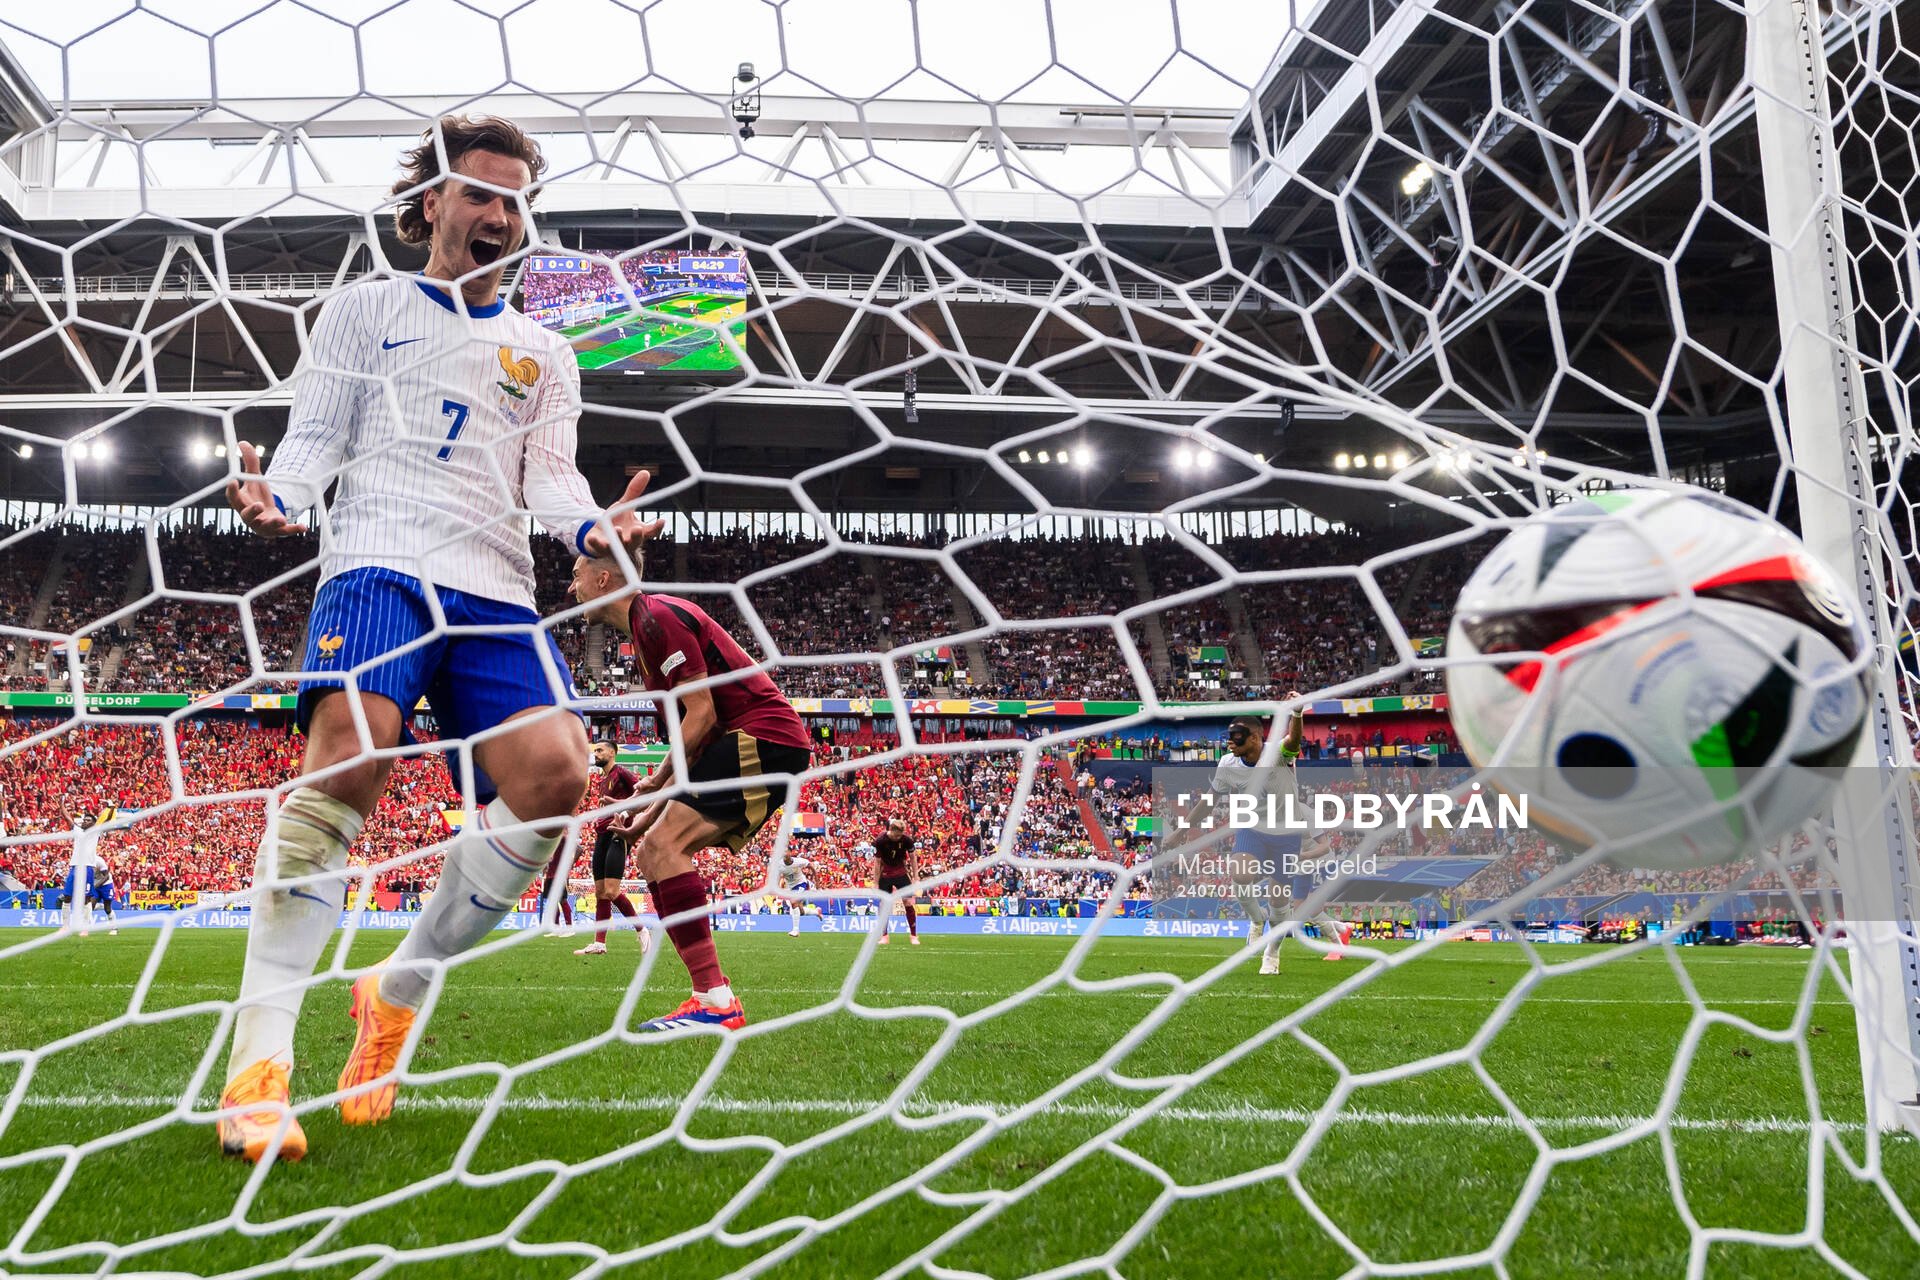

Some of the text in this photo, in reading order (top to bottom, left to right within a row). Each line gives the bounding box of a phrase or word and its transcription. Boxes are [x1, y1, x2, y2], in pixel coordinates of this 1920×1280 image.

[692, 261, 725, 270] 84:29
[437, 399, 470, 461] 7
[55, 694, 140, 705] DÜSELDORF
[173, 892, 195, 901] FANS
[368, 912, 420, 929] Alipay
